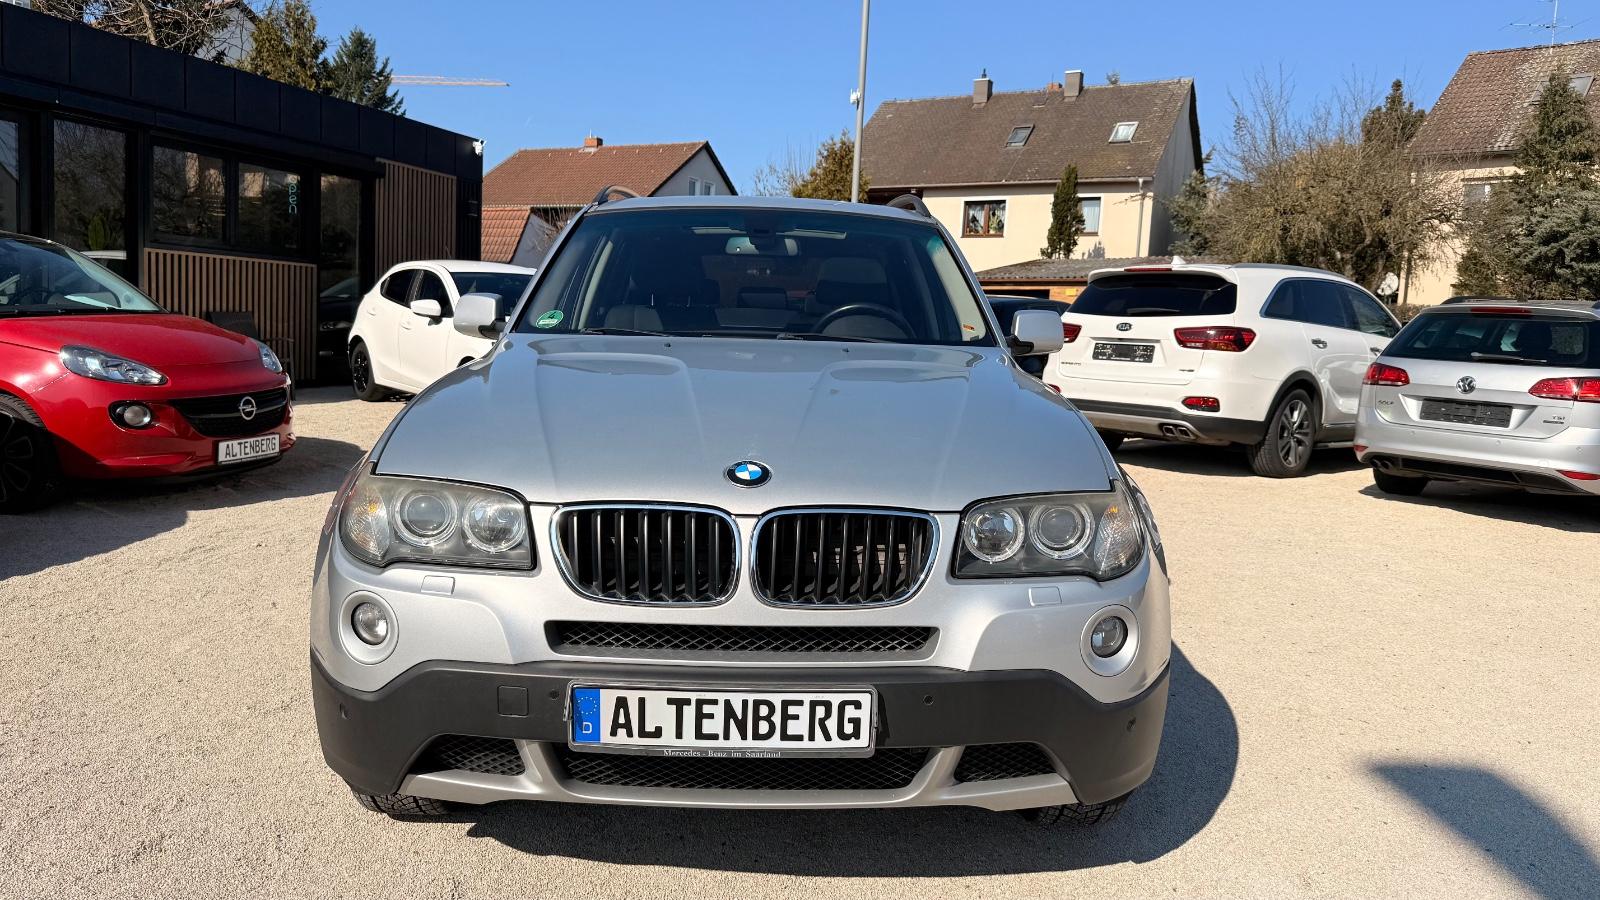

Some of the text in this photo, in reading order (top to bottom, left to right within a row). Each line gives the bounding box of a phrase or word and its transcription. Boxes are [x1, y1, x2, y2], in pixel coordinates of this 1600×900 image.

[1117, 322, 1132, 331] KIA
[224, 436, 277, 459] ALTENBERG
[582, 696, 862, 742] D ALTENBERG
[663, 749, 701, 757] Mercedes
